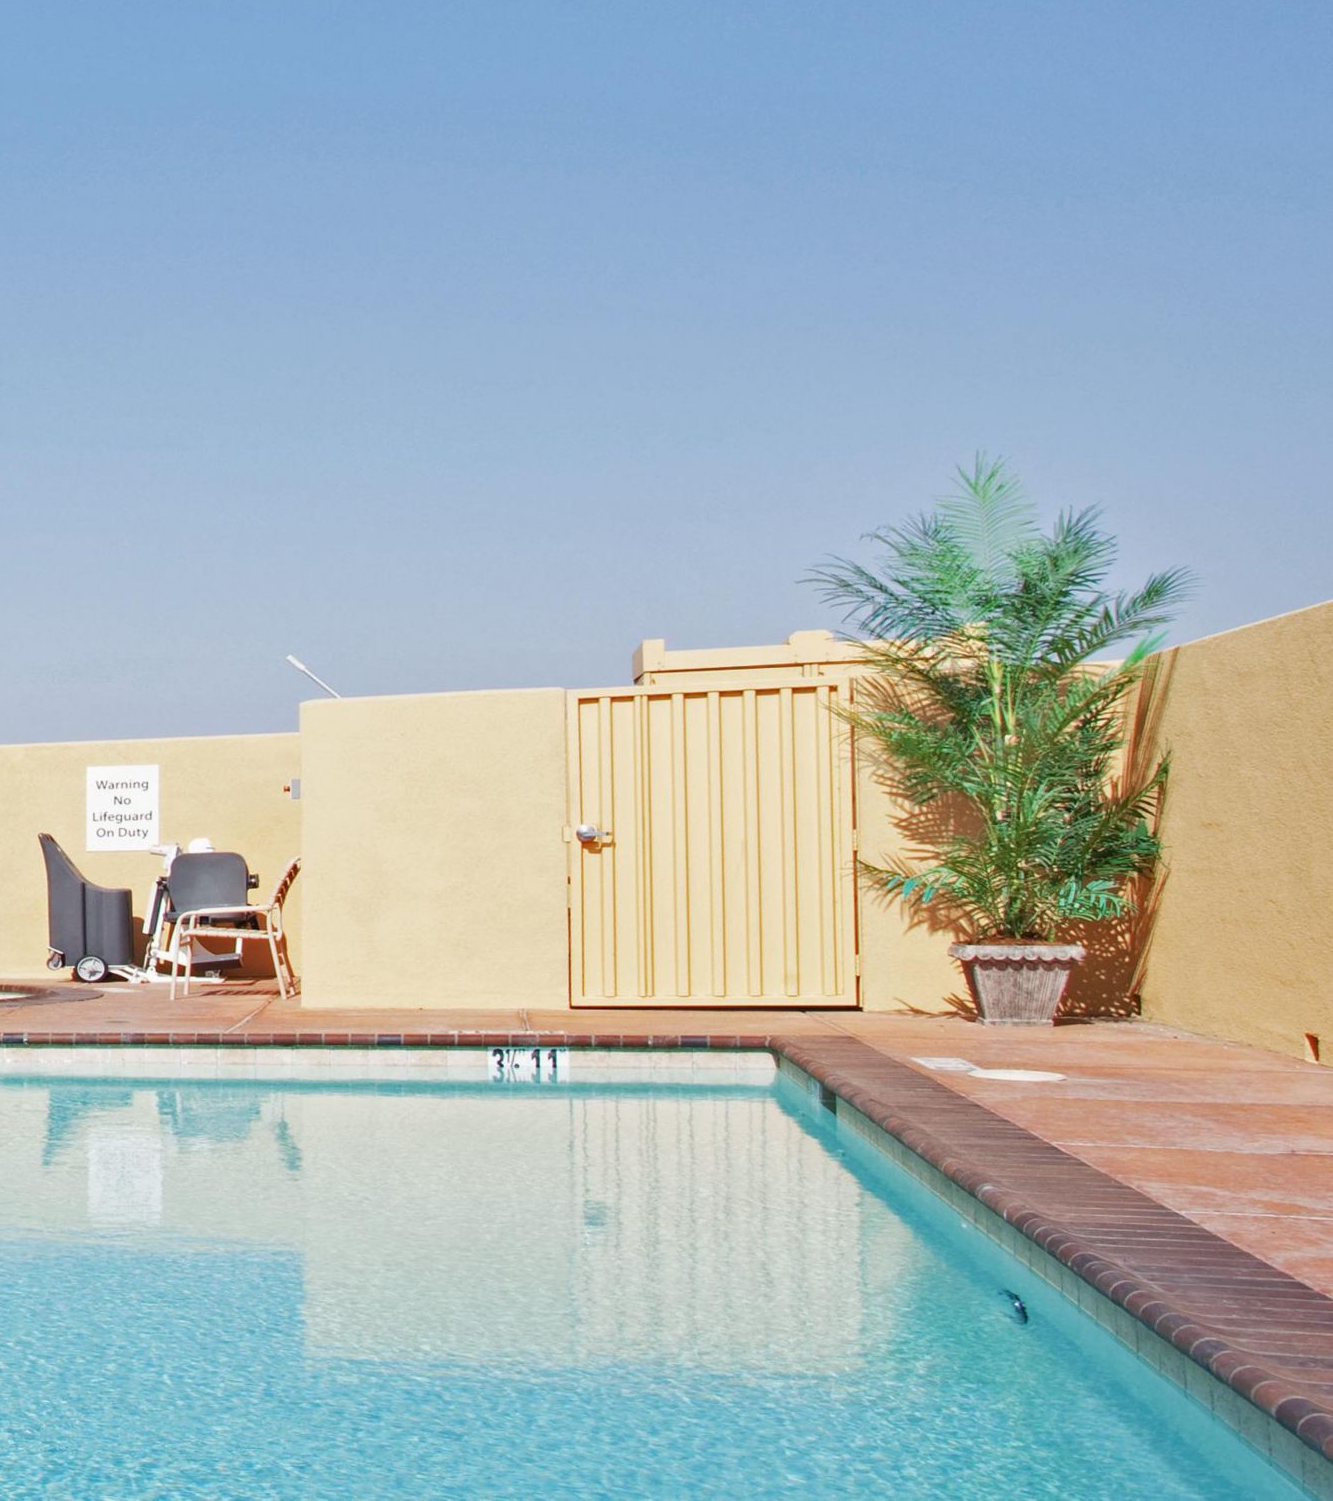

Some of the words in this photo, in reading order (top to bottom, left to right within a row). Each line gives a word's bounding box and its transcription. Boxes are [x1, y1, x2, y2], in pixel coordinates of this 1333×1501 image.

[96, 780, 149, 791] Warning
[113, 796, 132, 805] No
[92, 811, 153, 824] Lifeguard
[96, 827, 114, 838] On
[118, 827, 149, 839] Duty
